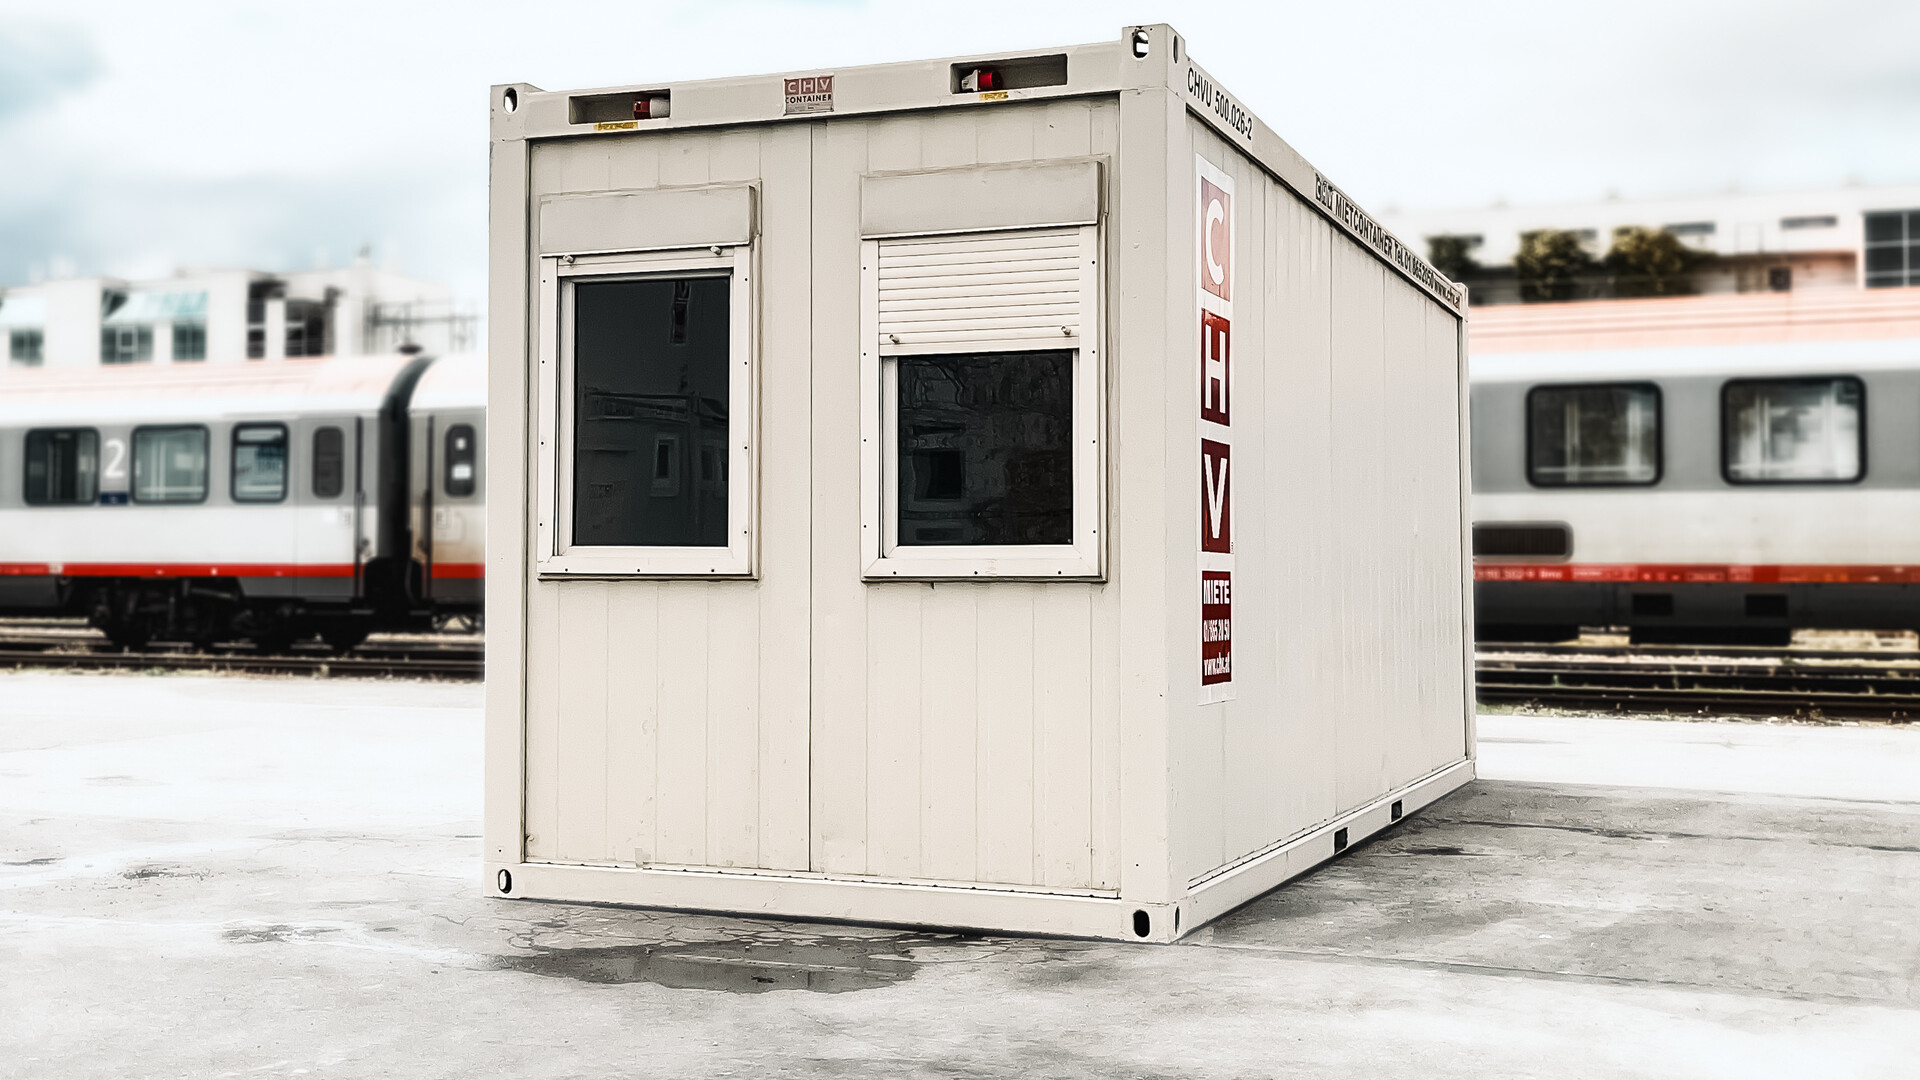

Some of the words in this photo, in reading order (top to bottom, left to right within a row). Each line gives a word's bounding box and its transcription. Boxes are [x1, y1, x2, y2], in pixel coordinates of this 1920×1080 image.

[786, 94, 832, 104] CONTAINER
[788, 79, 830, 93] CHV
[1188, 67, 1212, 107] CHVU
[1215, 90, 1252, 140] 500.026-2
[1336, 194, 1392, 260] MIETCONTAINER
[105, 439, 125, 477] 2
[1203, 580, 1230, 604] MIETE
